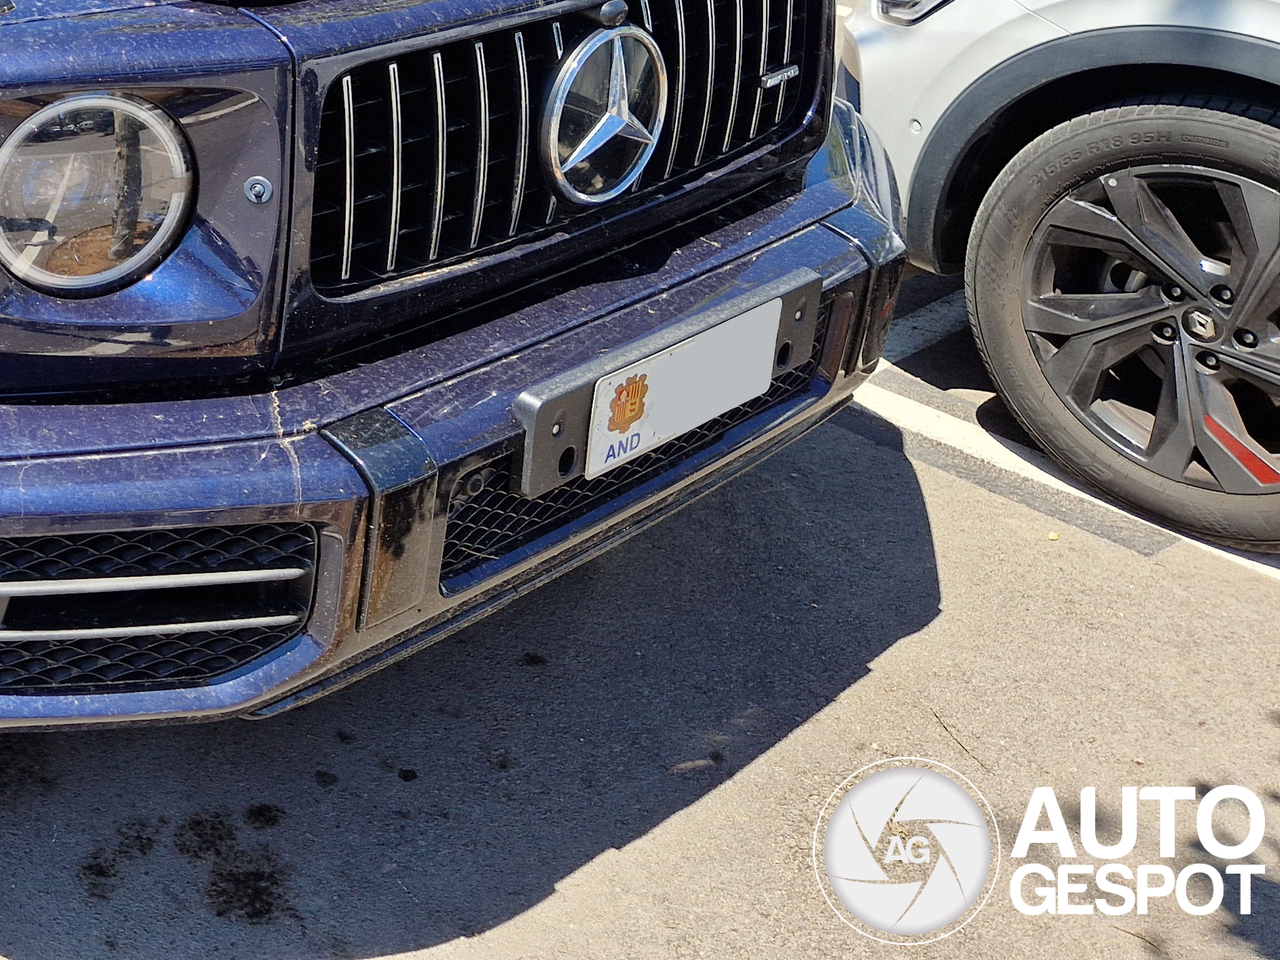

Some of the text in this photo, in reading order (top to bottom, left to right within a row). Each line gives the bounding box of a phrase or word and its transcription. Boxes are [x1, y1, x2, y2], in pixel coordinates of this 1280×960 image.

[1029, 150, 1083, 189] 215/55
[1086, 136, 1124, 156] R18
[1128, 131, 1172, 145] 95H
[605, 432, 640, 463] AND
